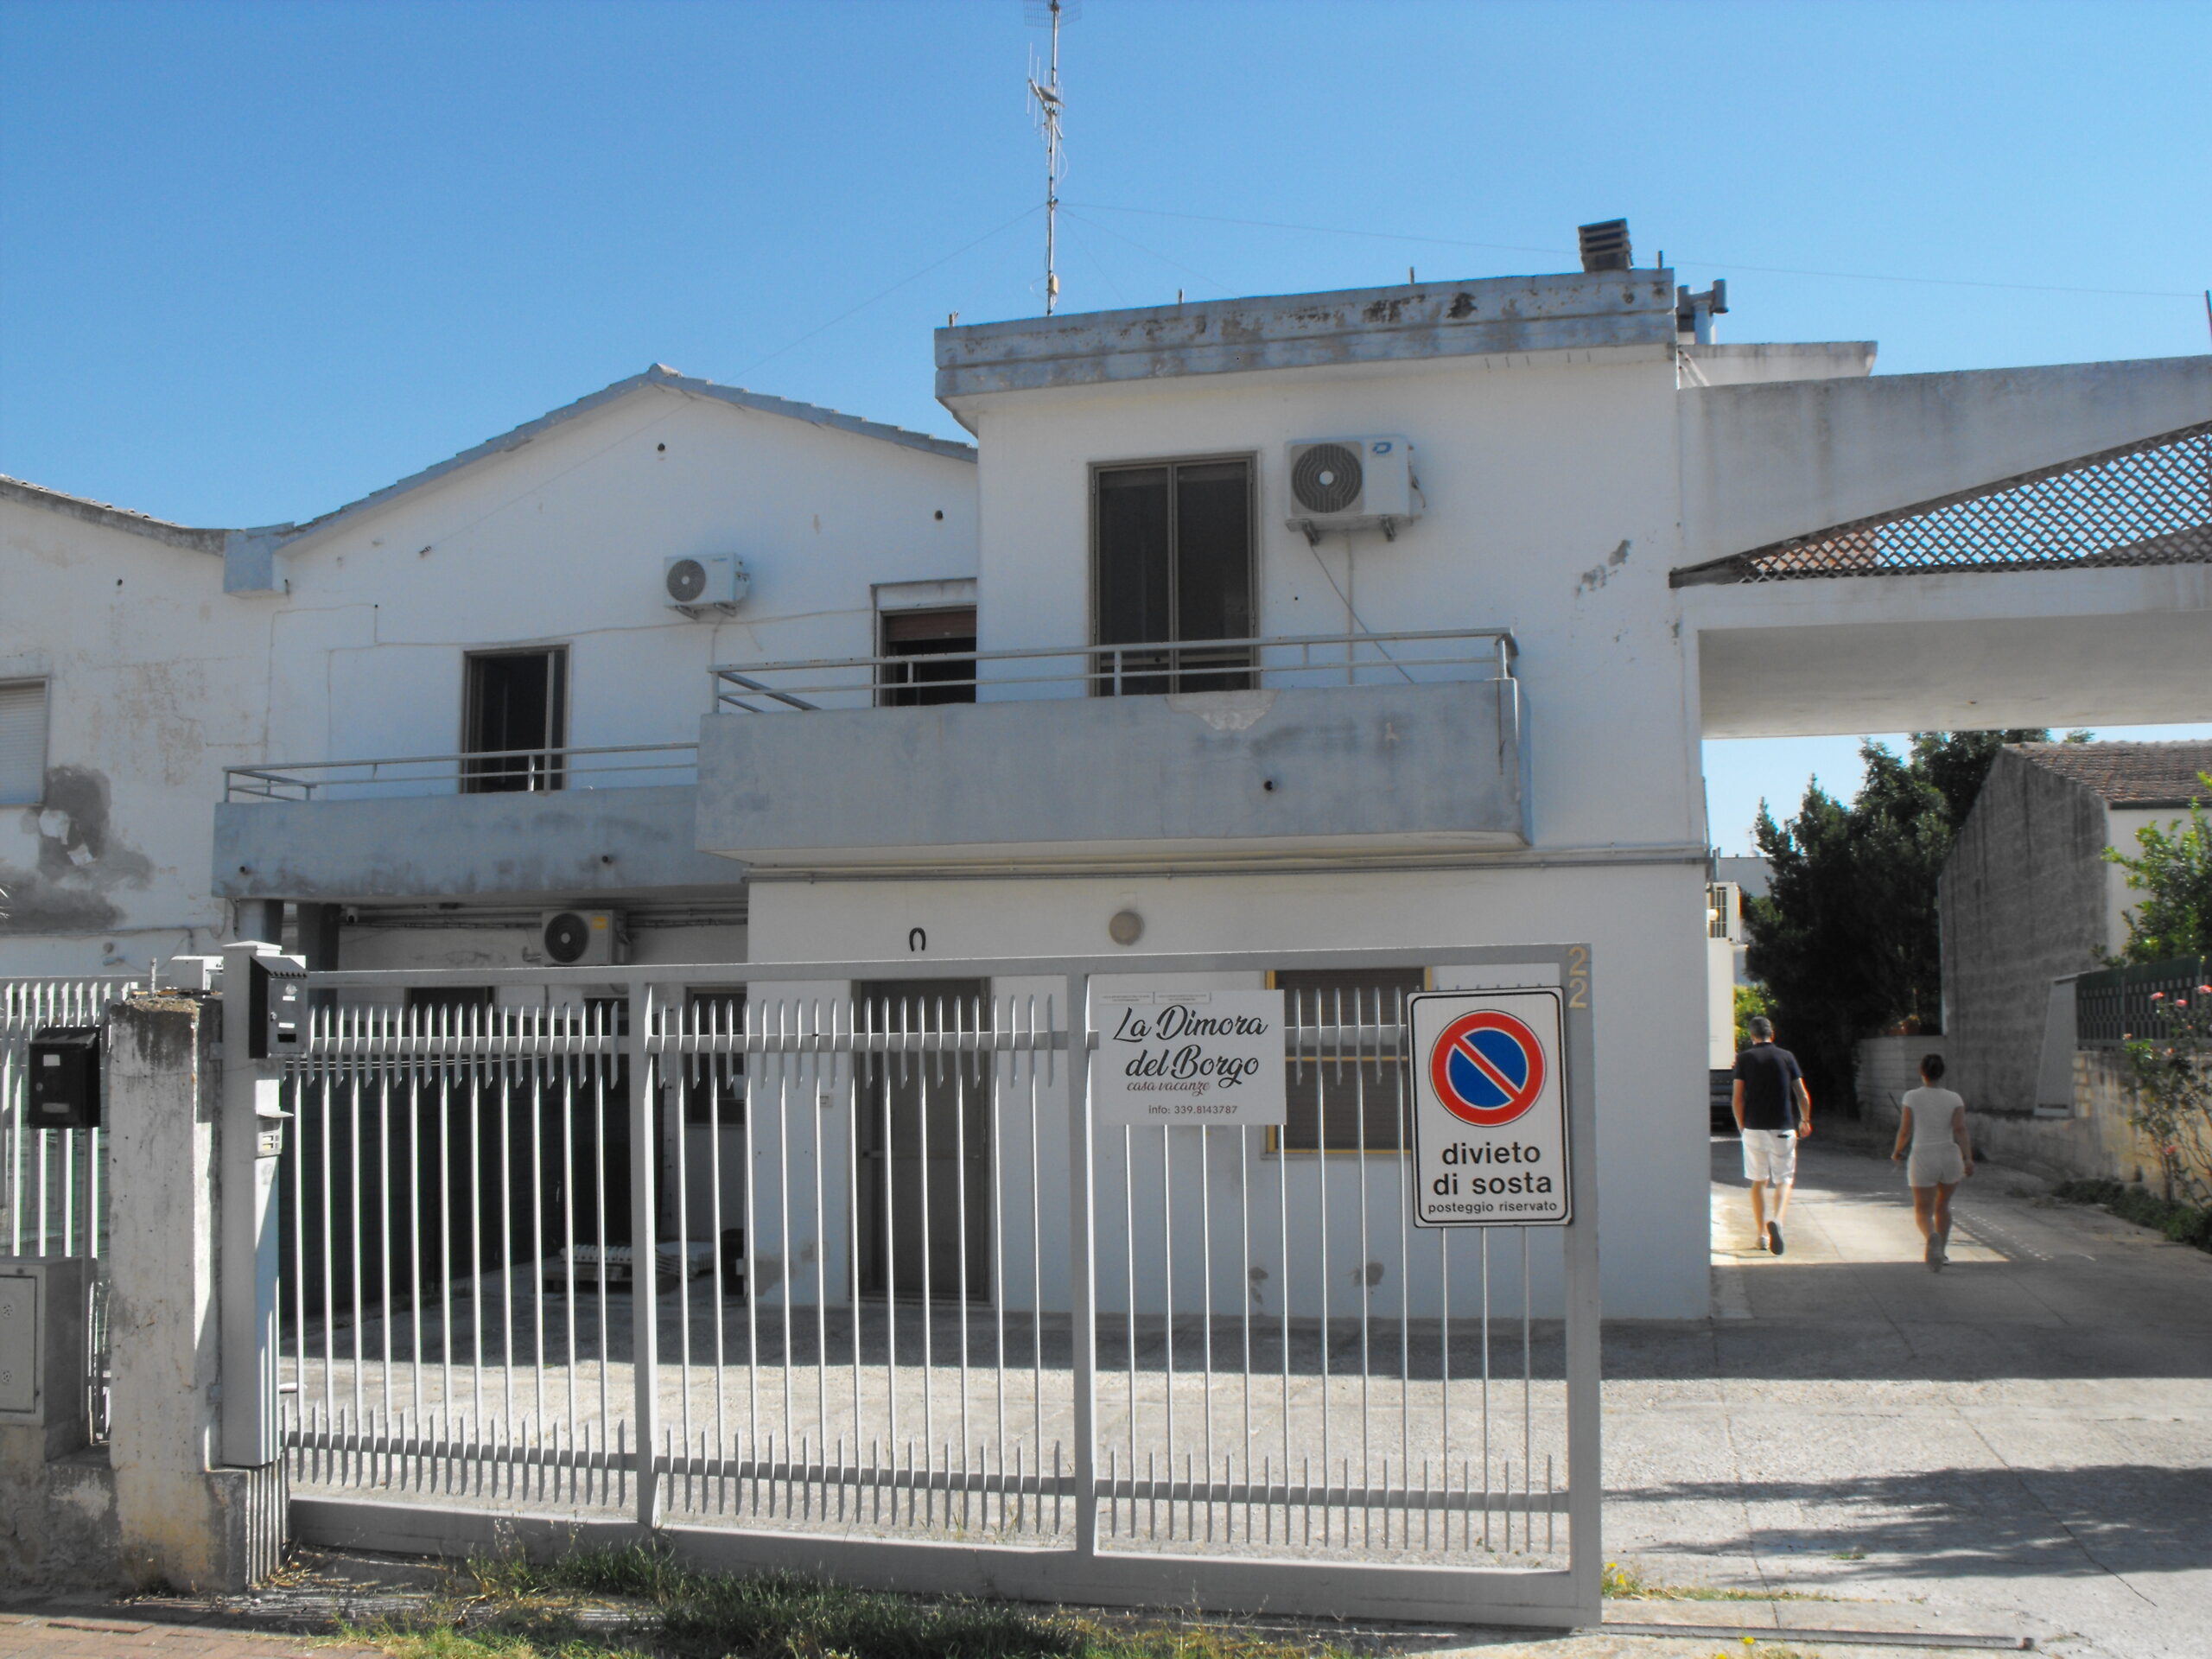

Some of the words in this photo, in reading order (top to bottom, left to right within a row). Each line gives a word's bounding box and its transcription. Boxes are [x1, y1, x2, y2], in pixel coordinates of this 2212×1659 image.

[1113, 1007, 1152, 1043] La
[1155, 1004, 1268, 1040] Dimora
[1125, 1049, 1170, 1077] del
[1170, 1044, 1259, 1089] Borgo
[1127, 1081, 1156, 1091] casa
[1158, 1080, 1210, 1096] vacanze
[1148, 1104, 1171, 1114] info:
[1174, 1104, 1238, 1114] 339.8143787
[1441, 1141, 1541, 1165] divieto
[1433, 1173, 1458, 1196] di
[1471, 1171, 1553, 1195] sosta
[1428, 1202, 1494, 1214] posteggio
[1499, 1200, 1557, 1212] riservato
